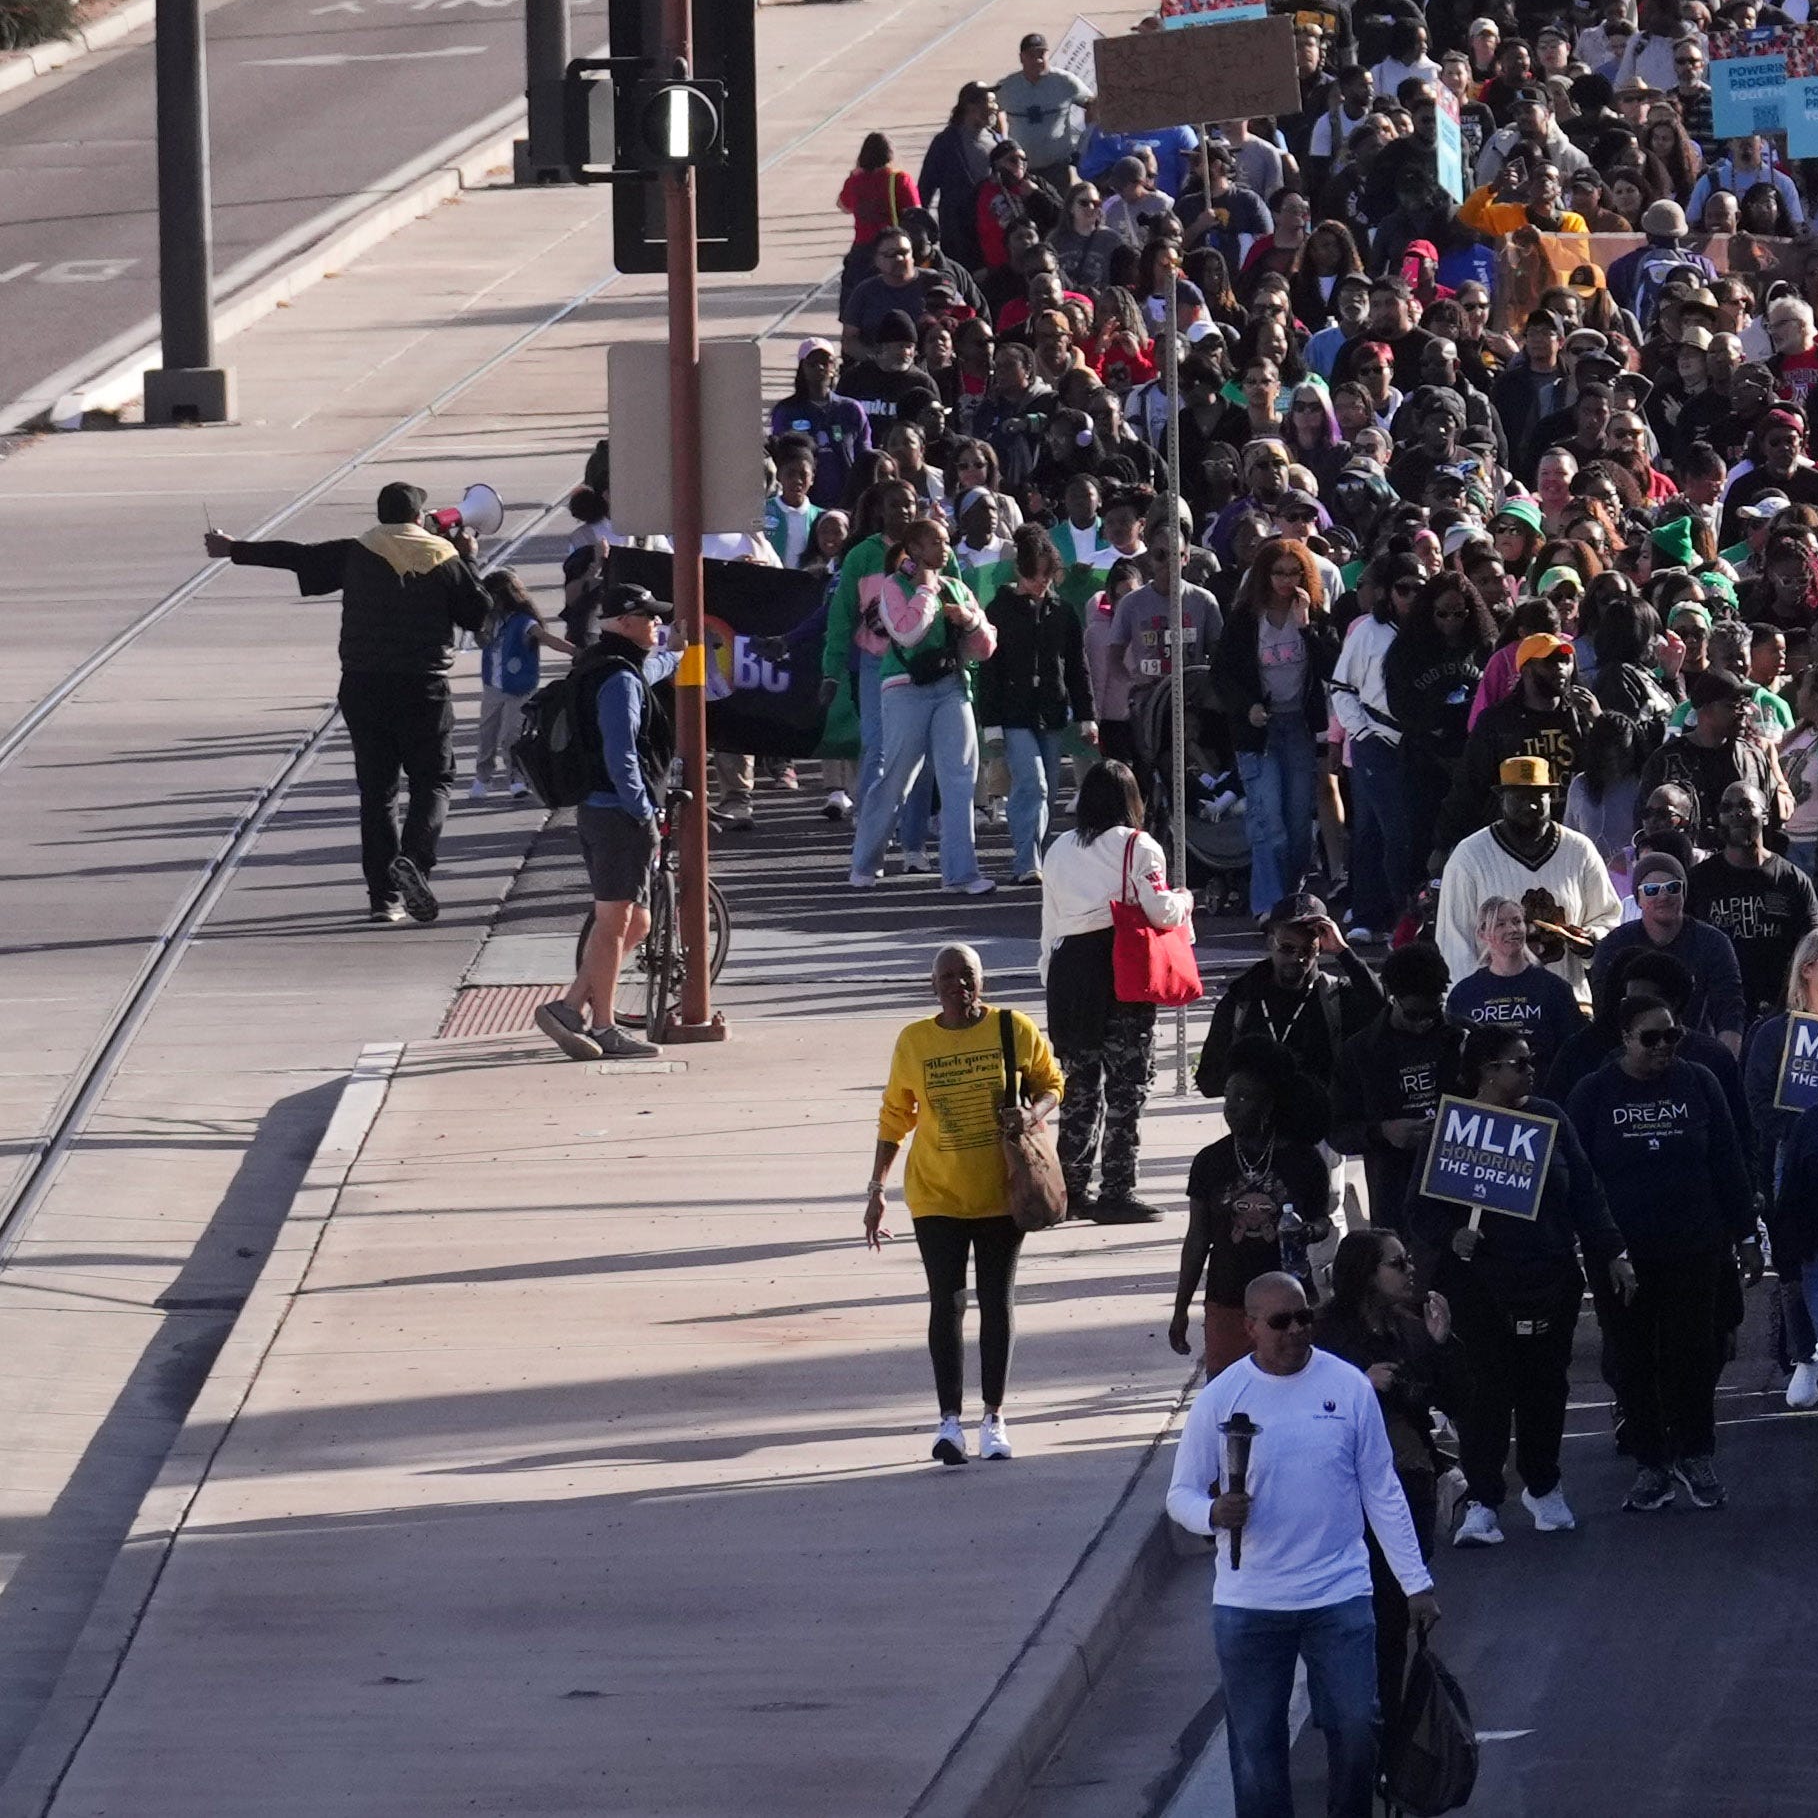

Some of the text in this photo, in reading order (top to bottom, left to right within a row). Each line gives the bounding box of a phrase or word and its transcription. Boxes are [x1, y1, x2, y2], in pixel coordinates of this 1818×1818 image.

[1710, 896, 1766, 917] ALPHA
[1472, 1004, 1542, 1023] DREAM
[975, 1064, 999, 1073] Facts
[1790, 1072, 1818, 1088] THE
[1612, 1103, 1689, 1125] DREAM
[1444, 1109, 1540, 1162] MLK
[1441, 1144, 1534, 1175] HONORING
[1439, 1157, 1532, 1190] THE DREAM
